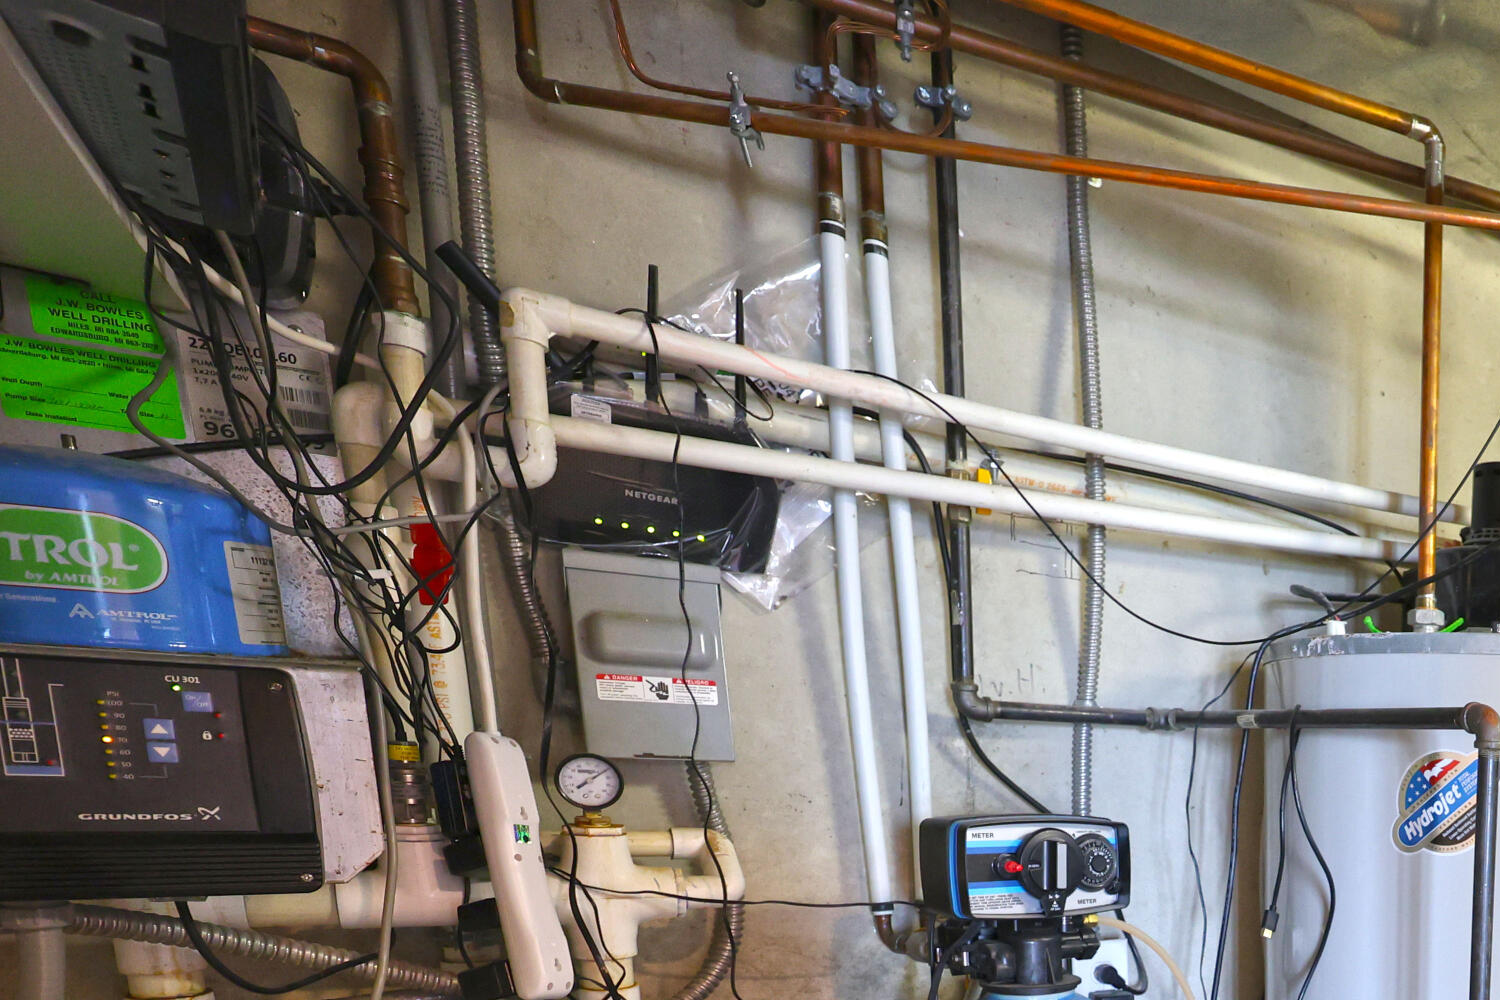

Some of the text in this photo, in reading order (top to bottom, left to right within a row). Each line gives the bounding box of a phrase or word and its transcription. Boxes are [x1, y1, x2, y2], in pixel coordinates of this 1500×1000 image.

[86, 303, 144, 320] BOWLES
[47, 307, 154, 333] WELL DRILLING
[28, 342, 75, 356] BOWLES
[77, 350, 105, 361] WELL
[624, 488, 680, 506] NETGEAR
[24, 570, 120, 586] by AMTROL
[97, 608, 173, 622] AMTROL
[164, 675, 200, 684] CU 301
[77, 812, 193, 822] GRUNDFOS
[1404, 782, 1462, 840] Hydrojet
[971, 832, 995, 840] METER
